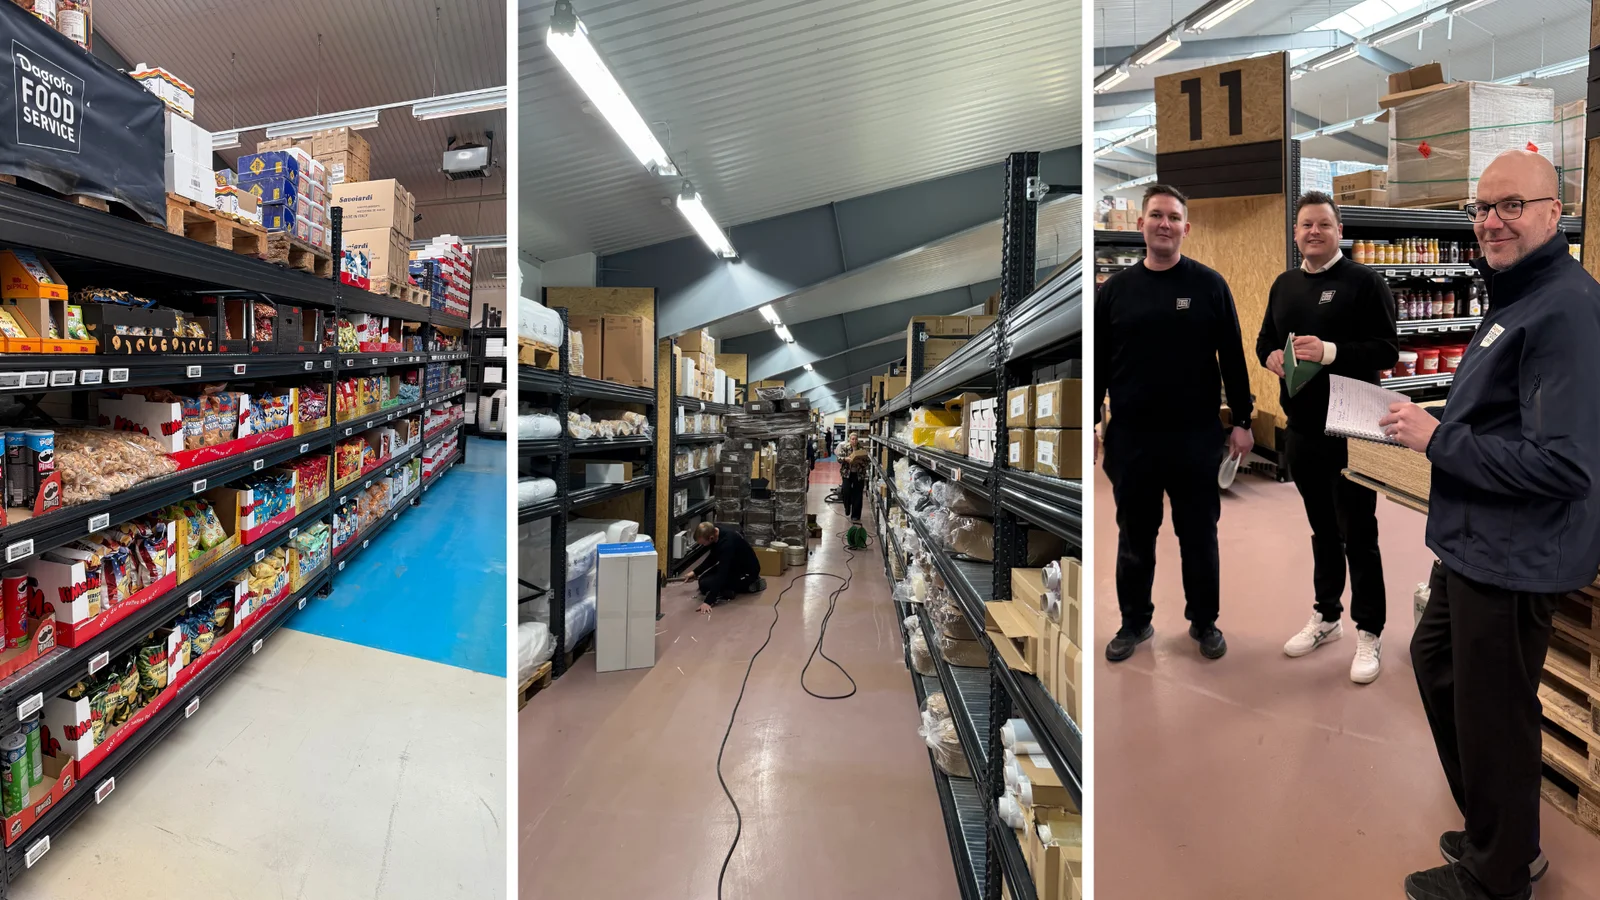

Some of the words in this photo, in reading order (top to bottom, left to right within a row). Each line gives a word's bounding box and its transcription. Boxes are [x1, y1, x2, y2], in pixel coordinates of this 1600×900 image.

[16, 53, 73, 96] Dagrofa
[22, 76, 75, 125] FOOD
[1180, 69, 1243, 141] 11
[23, 106, 75, 143] SERVICE
[339, 194, 373, 203] Savoiardi
